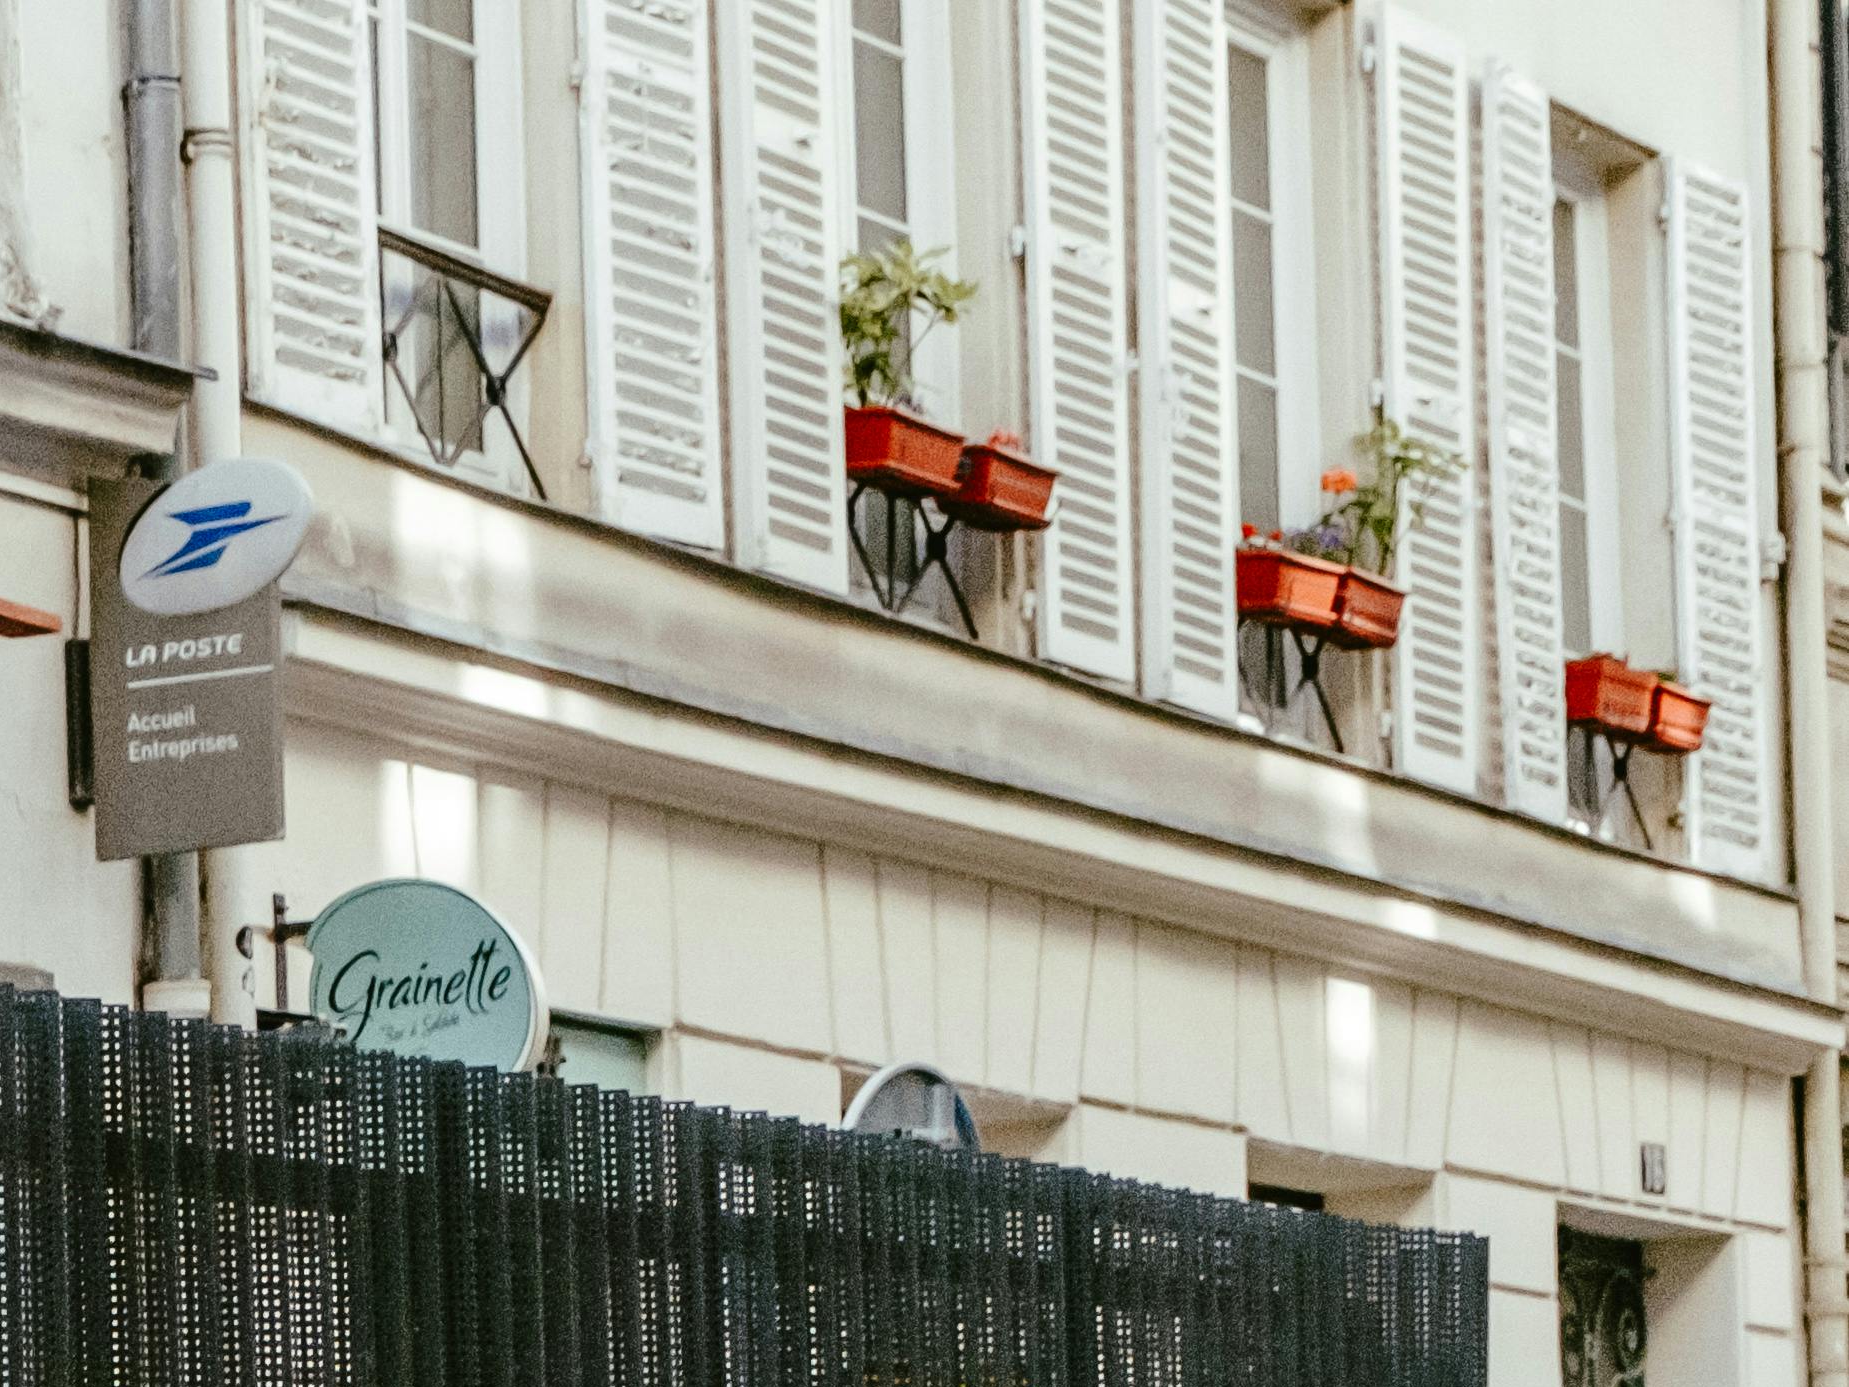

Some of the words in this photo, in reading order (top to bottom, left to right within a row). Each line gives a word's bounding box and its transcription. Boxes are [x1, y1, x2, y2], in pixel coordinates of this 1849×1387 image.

[126, 645, 157, 668] LA
[162, 633, 243, 663] POSTE
[127, 703, 196, 732] Accueil
[128, 734, 239, 763] Entreprises
[328, 938, 511, 1040] Grainette
